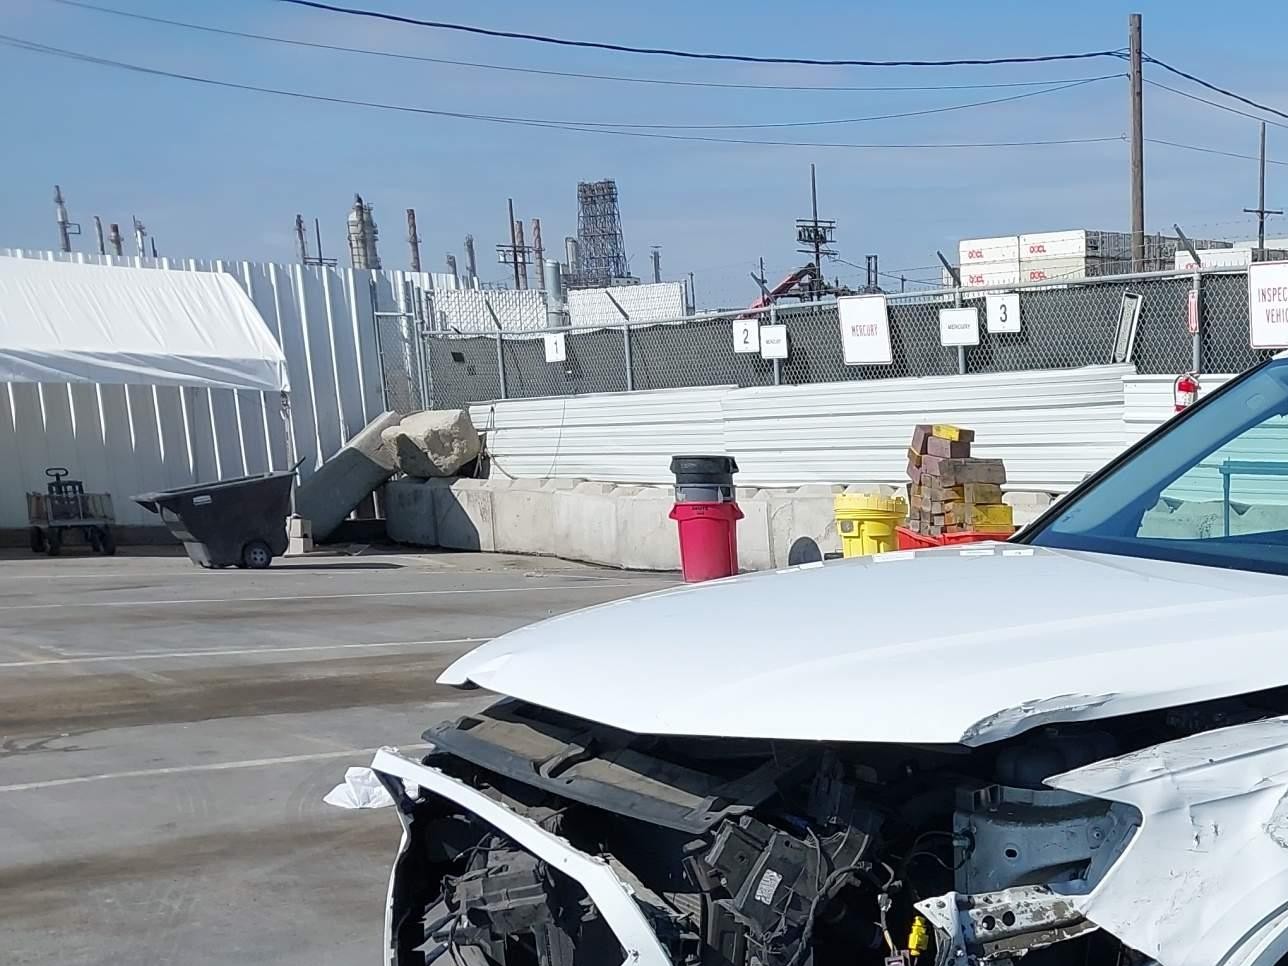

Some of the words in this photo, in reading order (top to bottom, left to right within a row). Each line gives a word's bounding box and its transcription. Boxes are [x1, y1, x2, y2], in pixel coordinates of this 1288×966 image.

[999, 304, 1008, 323] 3
[742, 328, 750, 345] 2
[851, 323, 878, 337] MERCURY
[554, 339, 560, 354] 1
